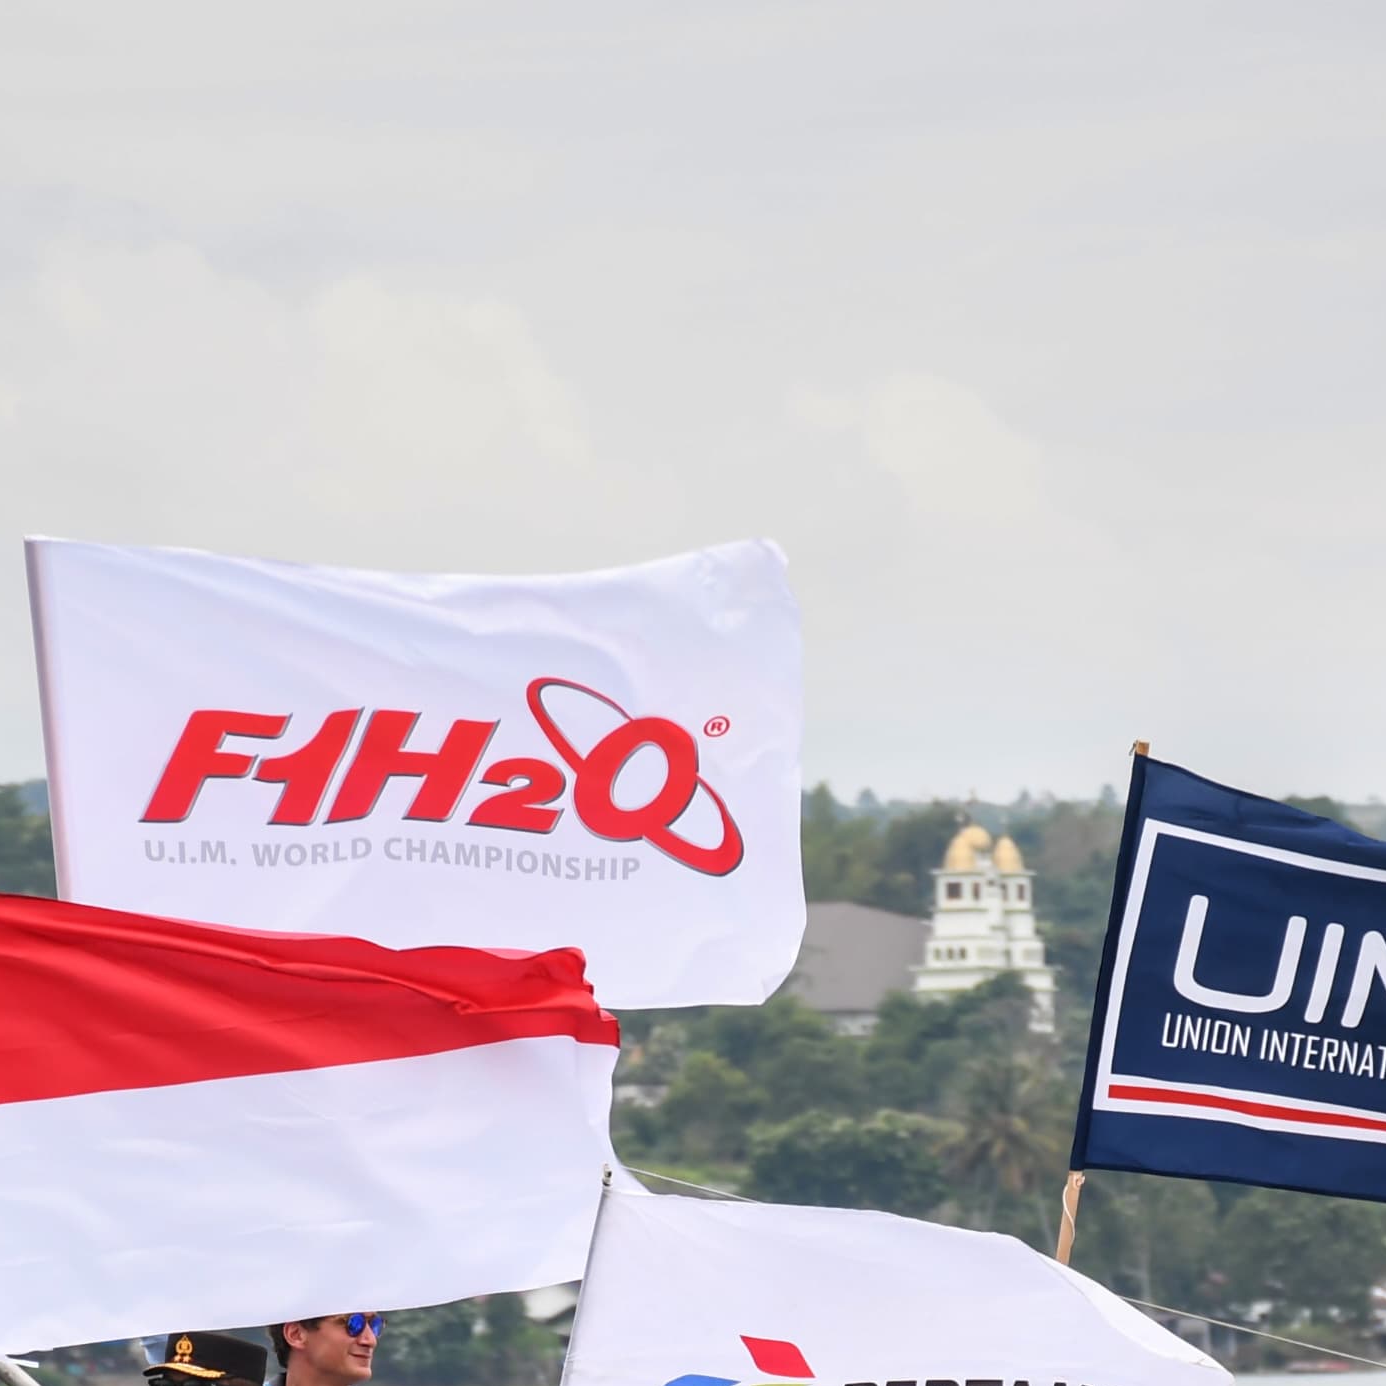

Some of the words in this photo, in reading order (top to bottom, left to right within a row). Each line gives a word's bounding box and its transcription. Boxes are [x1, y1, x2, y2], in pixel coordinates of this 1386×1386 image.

[138, 677, 744, 877] F1H2O
[143, 839, 238, 866] U.I.M.
[251, 838, 373, 869] WORLD
[382, 836, 642, 883] CHAMPIONSHIP
[1161, 1012, 1251, 1058] UNION
